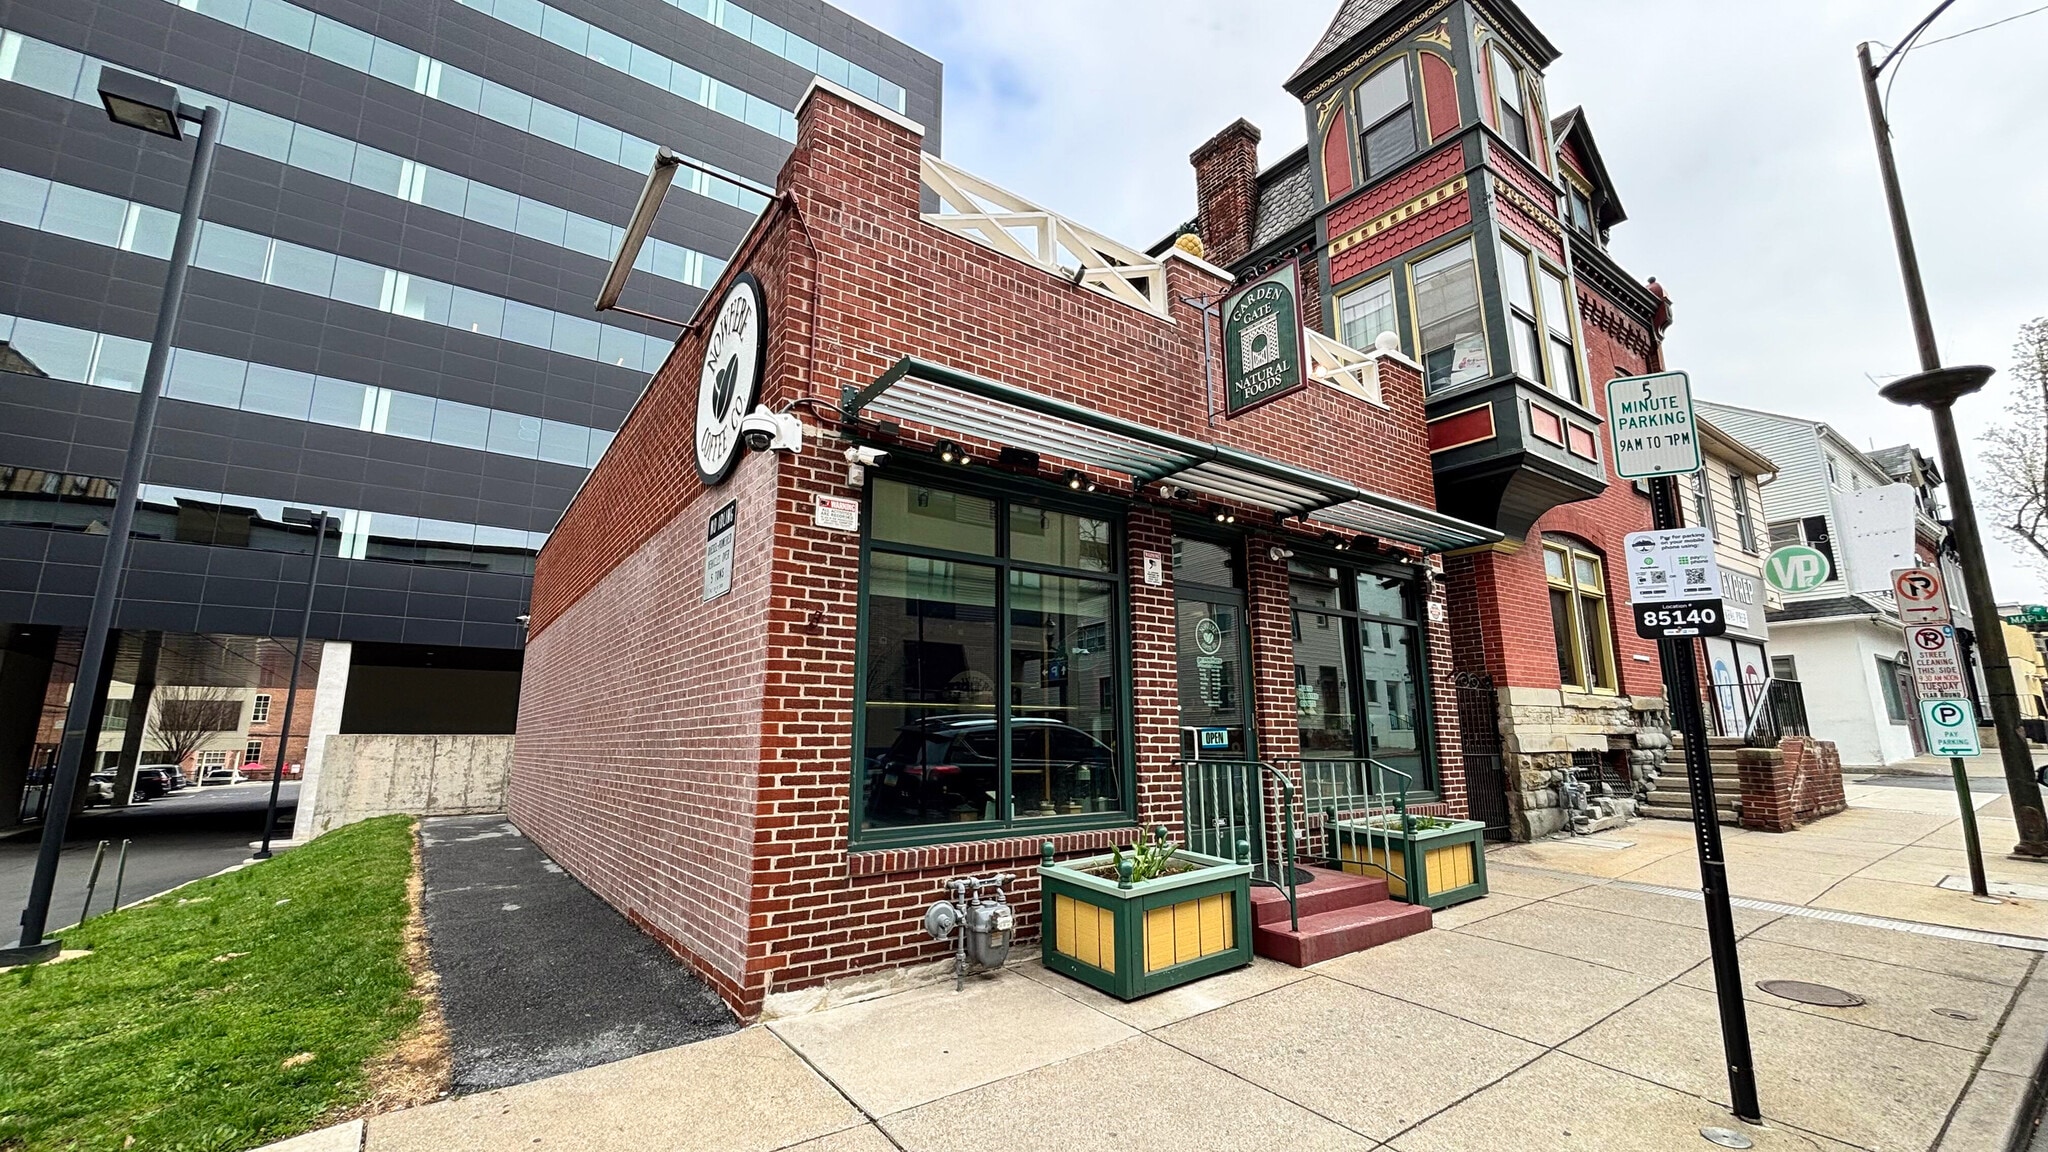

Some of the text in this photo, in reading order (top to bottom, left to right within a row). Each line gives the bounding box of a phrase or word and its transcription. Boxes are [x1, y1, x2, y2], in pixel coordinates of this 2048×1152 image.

[1233, 287, 1283, 322] GARDEN
[1243, 302, 1272, 324] GATE
[707, 297, 752, 374] NOWHERE
[1235, 360, 1291, 392] NATURAL
[1244, 374, 1282, 399] FOODS
[1642, 380, 1652, 401] 5
[1621, 395, 1679, 414] MINUTE
[1618, 411, 1686, 430] PARKING
[701, 425, 728, 462] COFFEE
[1620, 432, 1690, 452] 9AM TO 7PM
[1731, 574, 1754, 604] PREP
[1643, 608, 1716, 626] 85140
[1922, 682, 1959, 690] TUESDAY
[1205, 732, 1224, 744] OPEN
